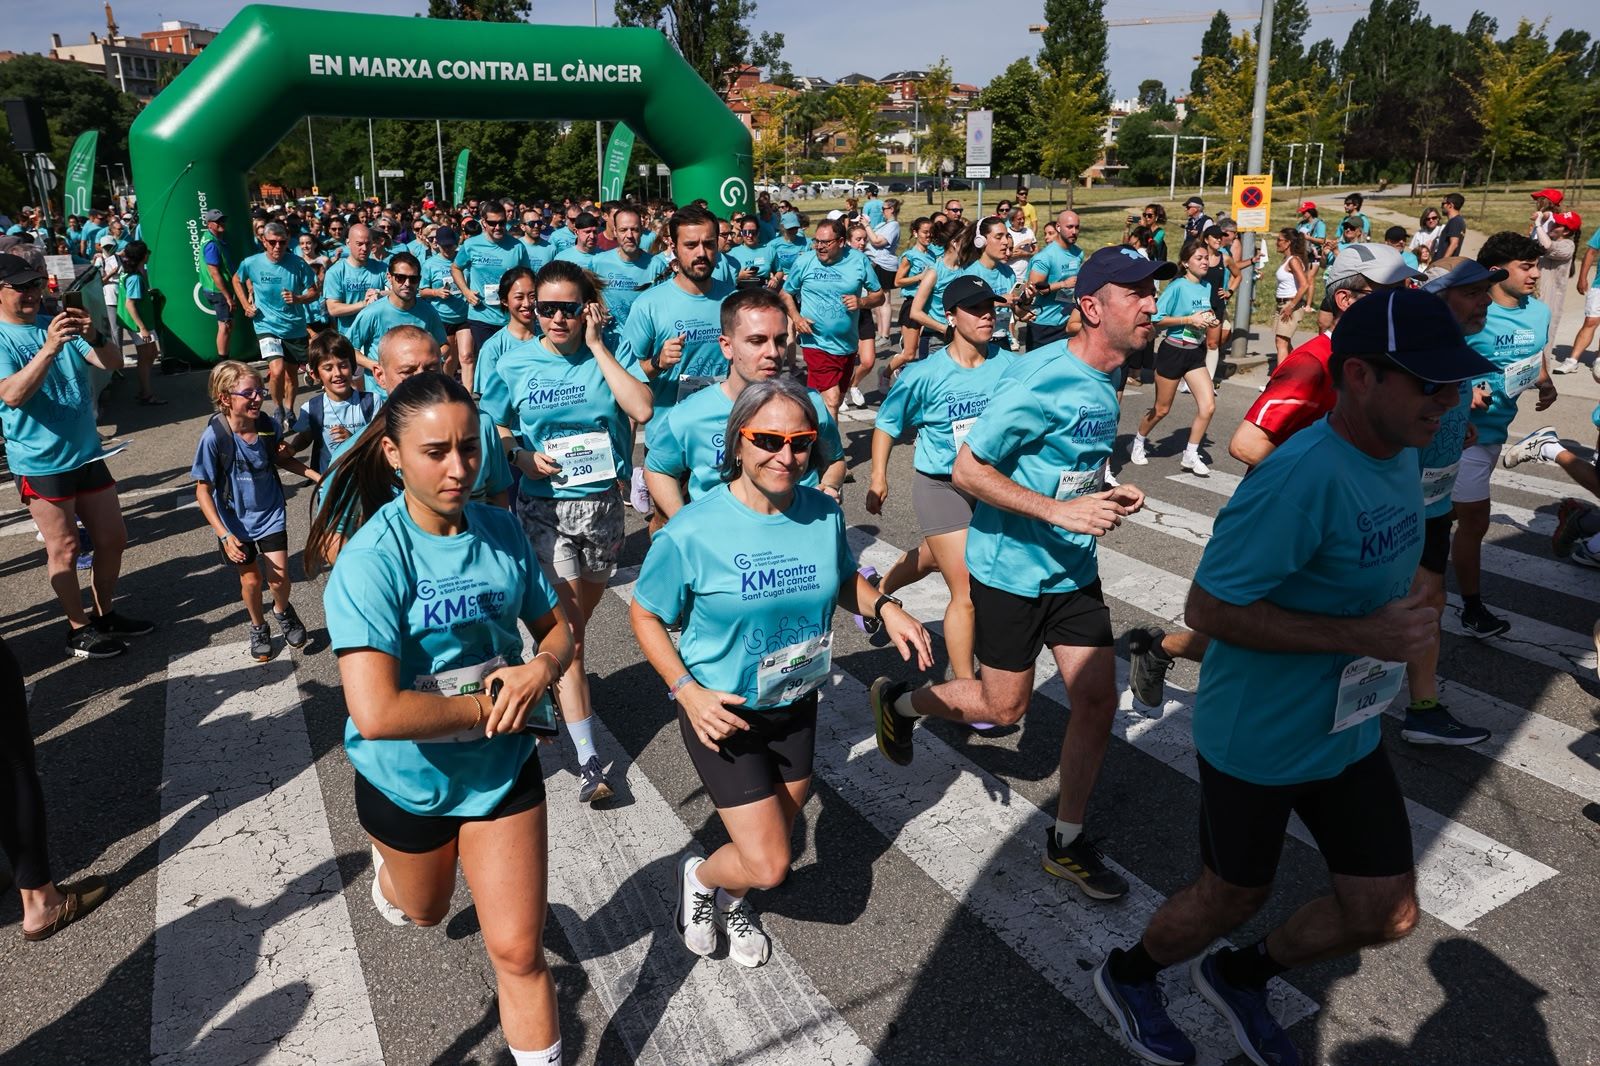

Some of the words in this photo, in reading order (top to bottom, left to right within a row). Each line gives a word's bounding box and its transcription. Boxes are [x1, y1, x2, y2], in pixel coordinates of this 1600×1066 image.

[309, 54, 343, 76] EN
[349, 56, 434, 79] MARXA
[437, 60, 529, 81] CONTRA
[533, 62, 558, 82] EL
[561, 58, 642, 83] CÀNCER
[608, 280, 622, 288] KM
[1496, 334, 1514, 346] KM
[529, 389, 554, 405] KM
[554, 385, 586, 396] contra
[541, 402, 559, 410] Cugat
[948, 401, 971, 418] KM
[1073, 420, 1099, 437] KM
[572, 464, 593, 476] 230
[1361, 526, 1394, 561] KM
[1393, 512, 1418, 537] contra
[742, 568, 776, 593] KM
[777, 564, 816, 579] contra
[777, 578, 785, 588] el
[742, 592, 761, 601] Sant
[763, 588, 785, 598] Cugat
[786, 585, 797, 594] del
[798, 583, 820, 592] Vallès
[424, 595, 467, 628] KM
[468, 589, 505, 607] contra
[468, 606, 477, 618] el
[787, 678, 804, 691] 30
[1356, 692, 1377, 711] 120
